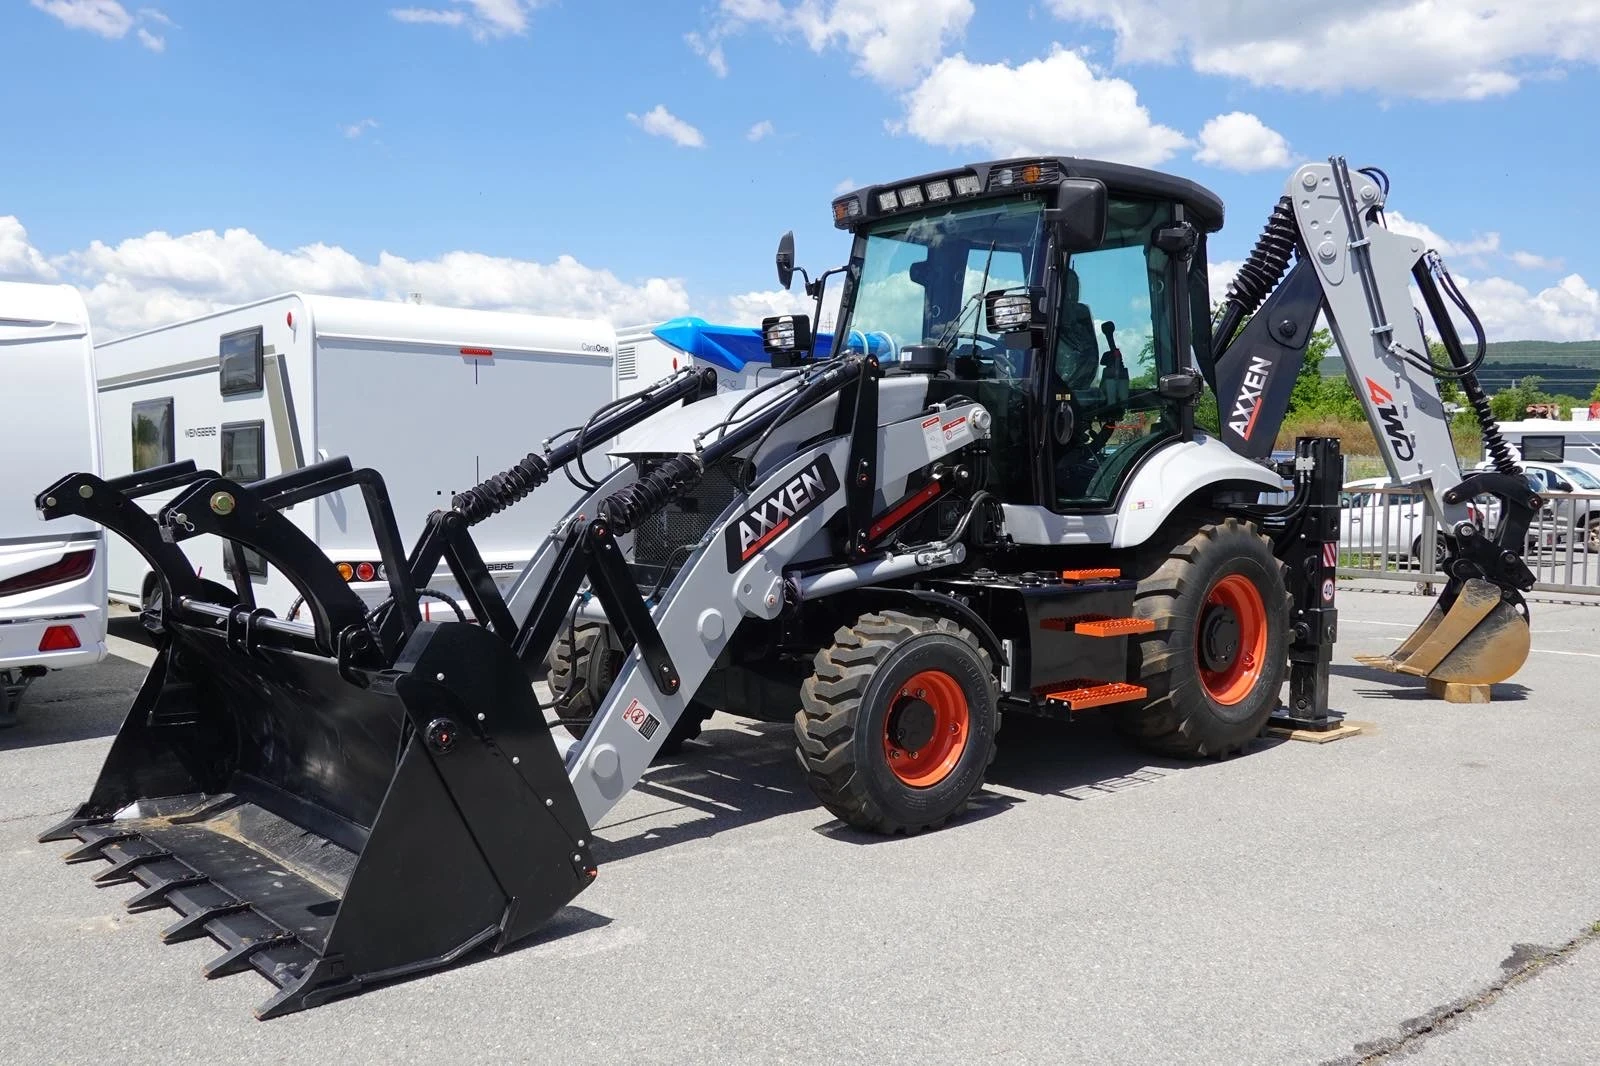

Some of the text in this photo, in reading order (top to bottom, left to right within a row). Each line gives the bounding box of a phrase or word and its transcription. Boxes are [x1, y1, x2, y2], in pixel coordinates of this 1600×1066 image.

[581, 343, 609, 353] CaraOne
[1228, 356, 1273, 439] AXXEN
[1364, 376, 1414, 462] 4WD
[738, 464, 827, 554] AXXEN
[485, 563, 514, 571] BERG
